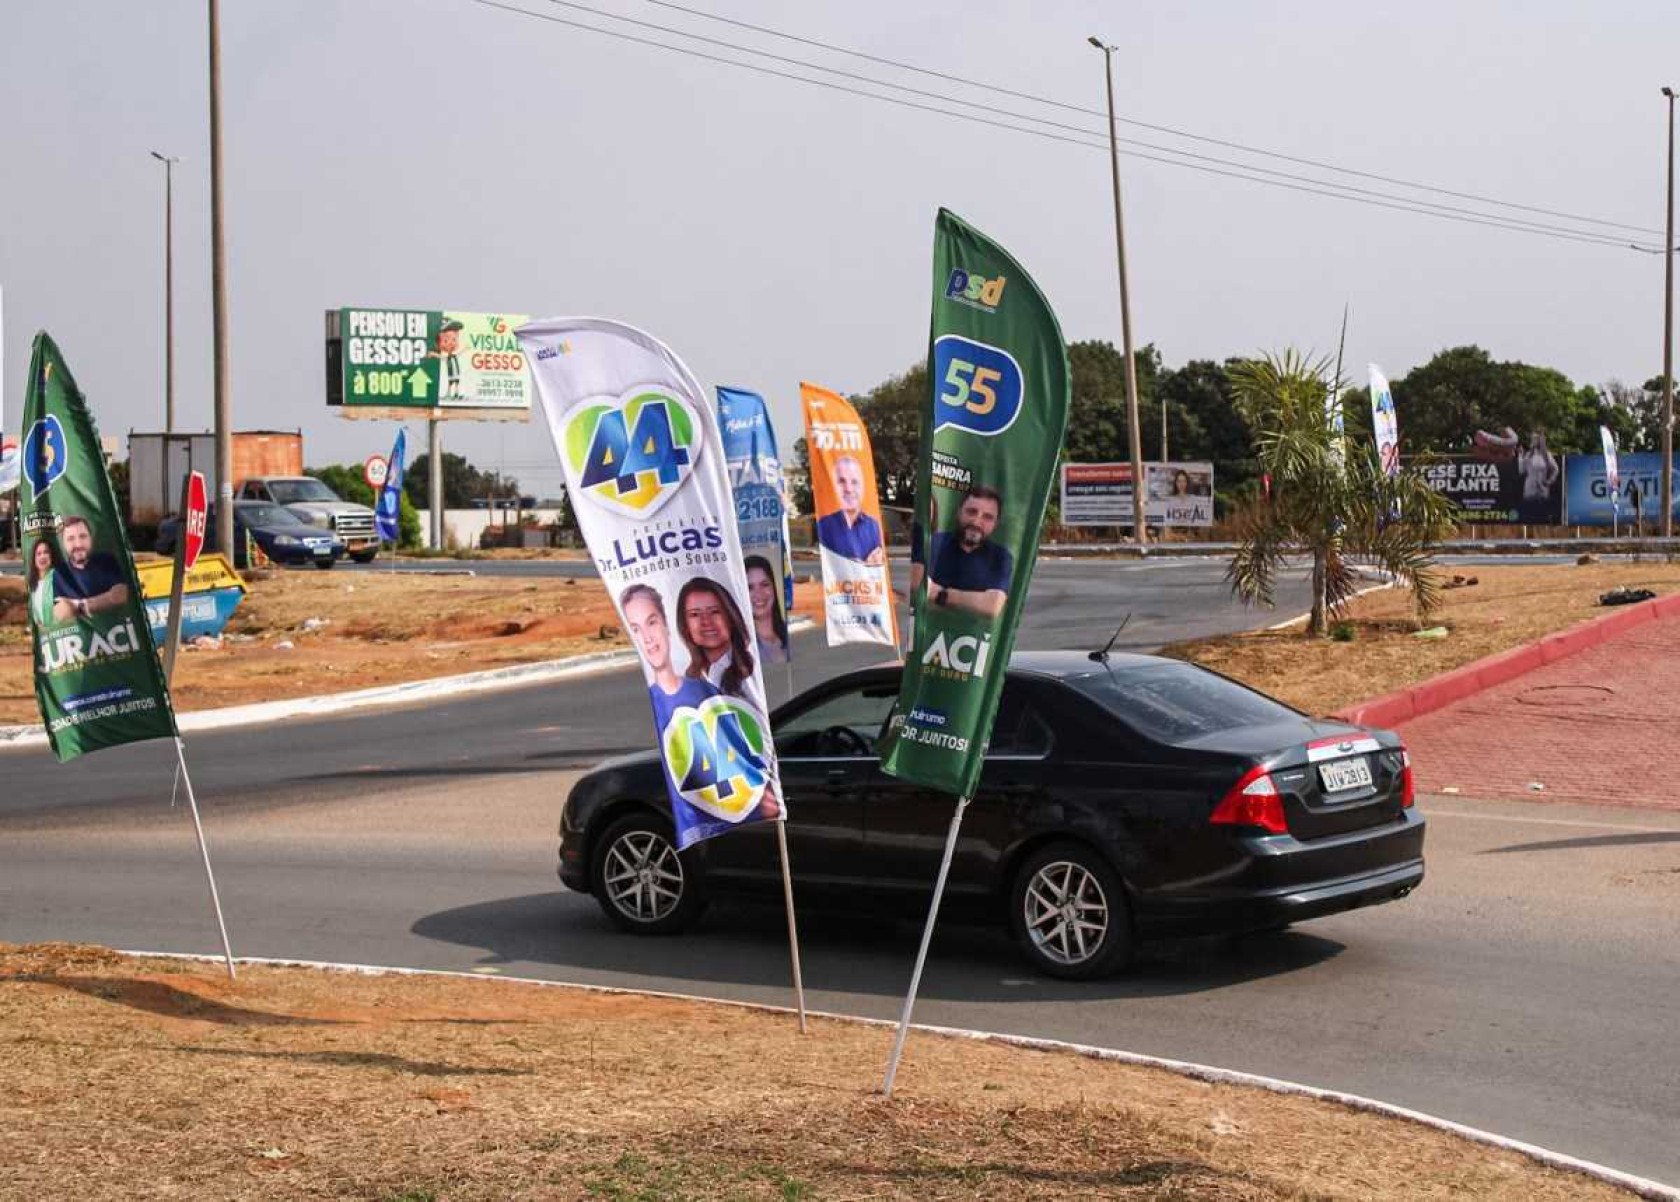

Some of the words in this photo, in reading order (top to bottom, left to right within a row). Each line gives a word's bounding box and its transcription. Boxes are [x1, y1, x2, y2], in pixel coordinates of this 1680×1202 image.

[945, 268, 1006, 306] psd
[349, 311, 404, 337] PENSOU
[406, 313, 427, 338] EM
[349, 338, 427, 365] GESSO?
[470, 333, 524, 351] VISUAL
[471, 353, 523, 370] GESSO
[941, 358, 1001, 414] 55
[580, 402, 691, 495] 44
[1461, 464, 1499, 477] FIXA
[613, 526, 723, 568] Lucas
[685, 551, 728, 566] Sousa
[680, 712, 769, 800] 44
